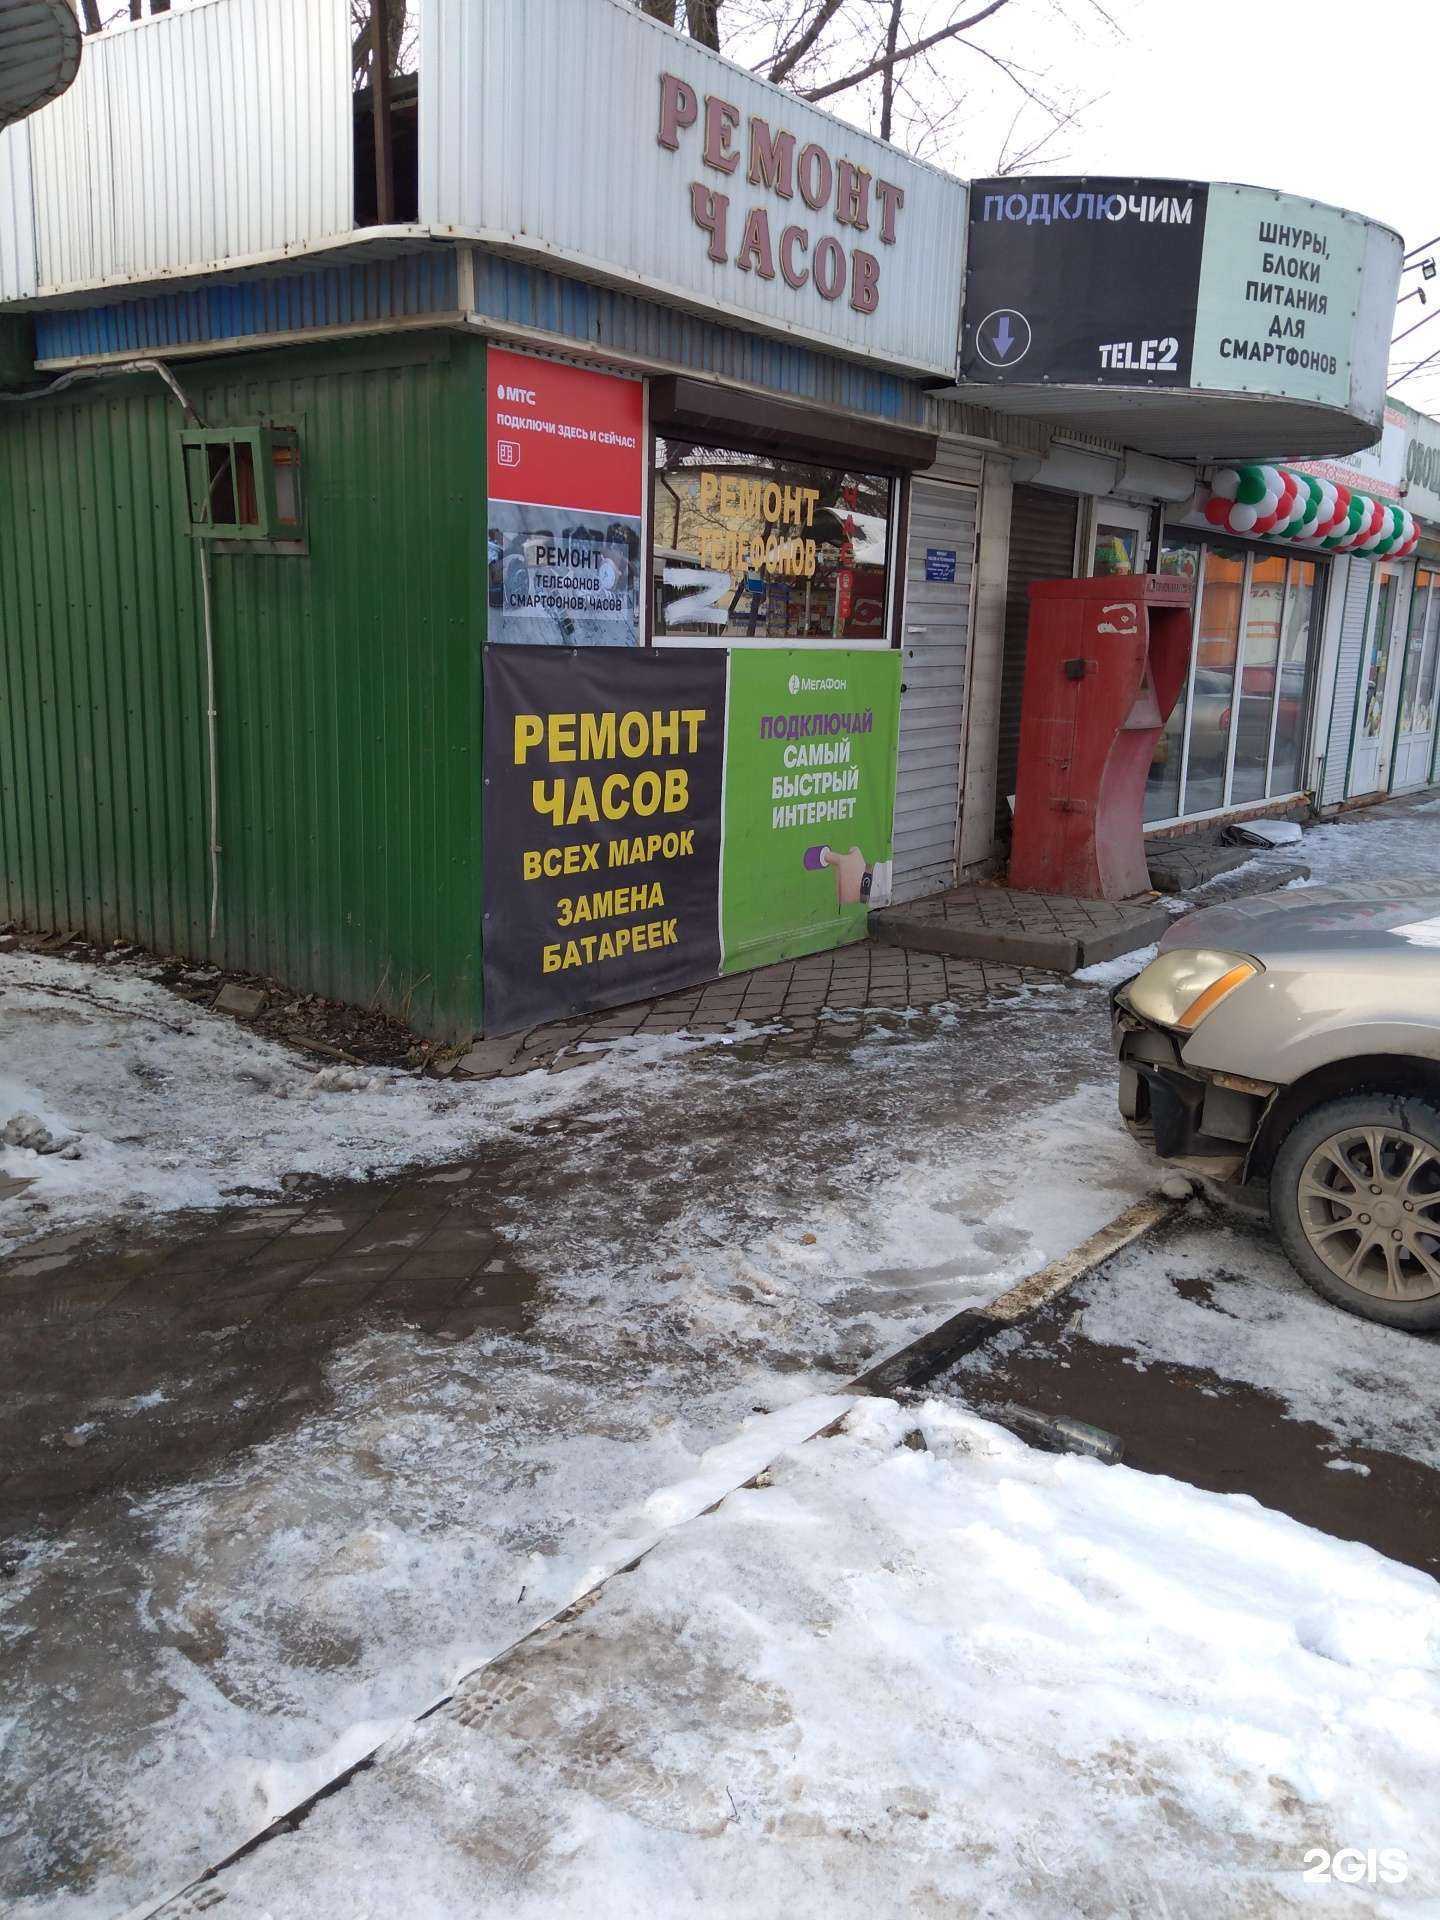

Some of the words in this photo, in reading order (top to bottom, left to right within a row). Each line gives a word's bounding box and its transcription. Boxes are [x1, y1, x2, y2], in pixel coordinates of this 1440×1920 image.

[657, 71, 904, 245] РЕМОНТ
[984, 193, 1193, 226] ПОДКЛЮЧИМ
[690, 181, 880, 315] ЧАСОВ
[1259, 221, 1330, 260] ШНУРЫ,
[1262, 253, 1321, 284] БЛОКИ
[1245, 280, 1328, 315] ПИТАНИЯ
[1268, 315, 1305, 339] ДЛЯ
[1099, 337, 1178, 371] TELE2
[1219, 338, 1337, 375] СМАРТФОНОВ
[506, 386, 536, 406] МТС
[496, 413, 556, 434] ПОДКЛЮЧИ
[557, 424, 588, 440] ЗДЕСЬ
[589, 430, 597, 441] И
[598, 432, 636, 449] СЕЙЧАС!
[701, 472, 820, 527] РЕМОНТ
[536, 545, 601, 570] РЕМОНТ
[697, 527, 817, 577] ТЕЛЕФОНОВ
[536, 574, 600, 591] ТЕЛЕФОНОВ
[510, 593, 588, 611] СМАРТФОНОВ,
[589, 598, 623, 611] ЧАСОВ
[513, 709, 706, 765] РЕМОНТ
[760, 707, 872, 740] ПОДКЛЮЧАЙ
[783, 737, 850, 768] САМЫЙ
[532, 768, 689, 826] ЧАСОВ
[772, 765, 859, 799] БЫСТРЫЙ
[772, 798, 856, 829] ИНТЕРНЕТ
[523, 843, 600, 881] ВСЕХ
[608, 829, 695, 867] МАРОК
[556, 882, 665, 927] ЗАМЕНА
[542, 918, 678, 974] БАТАРЕЕК
